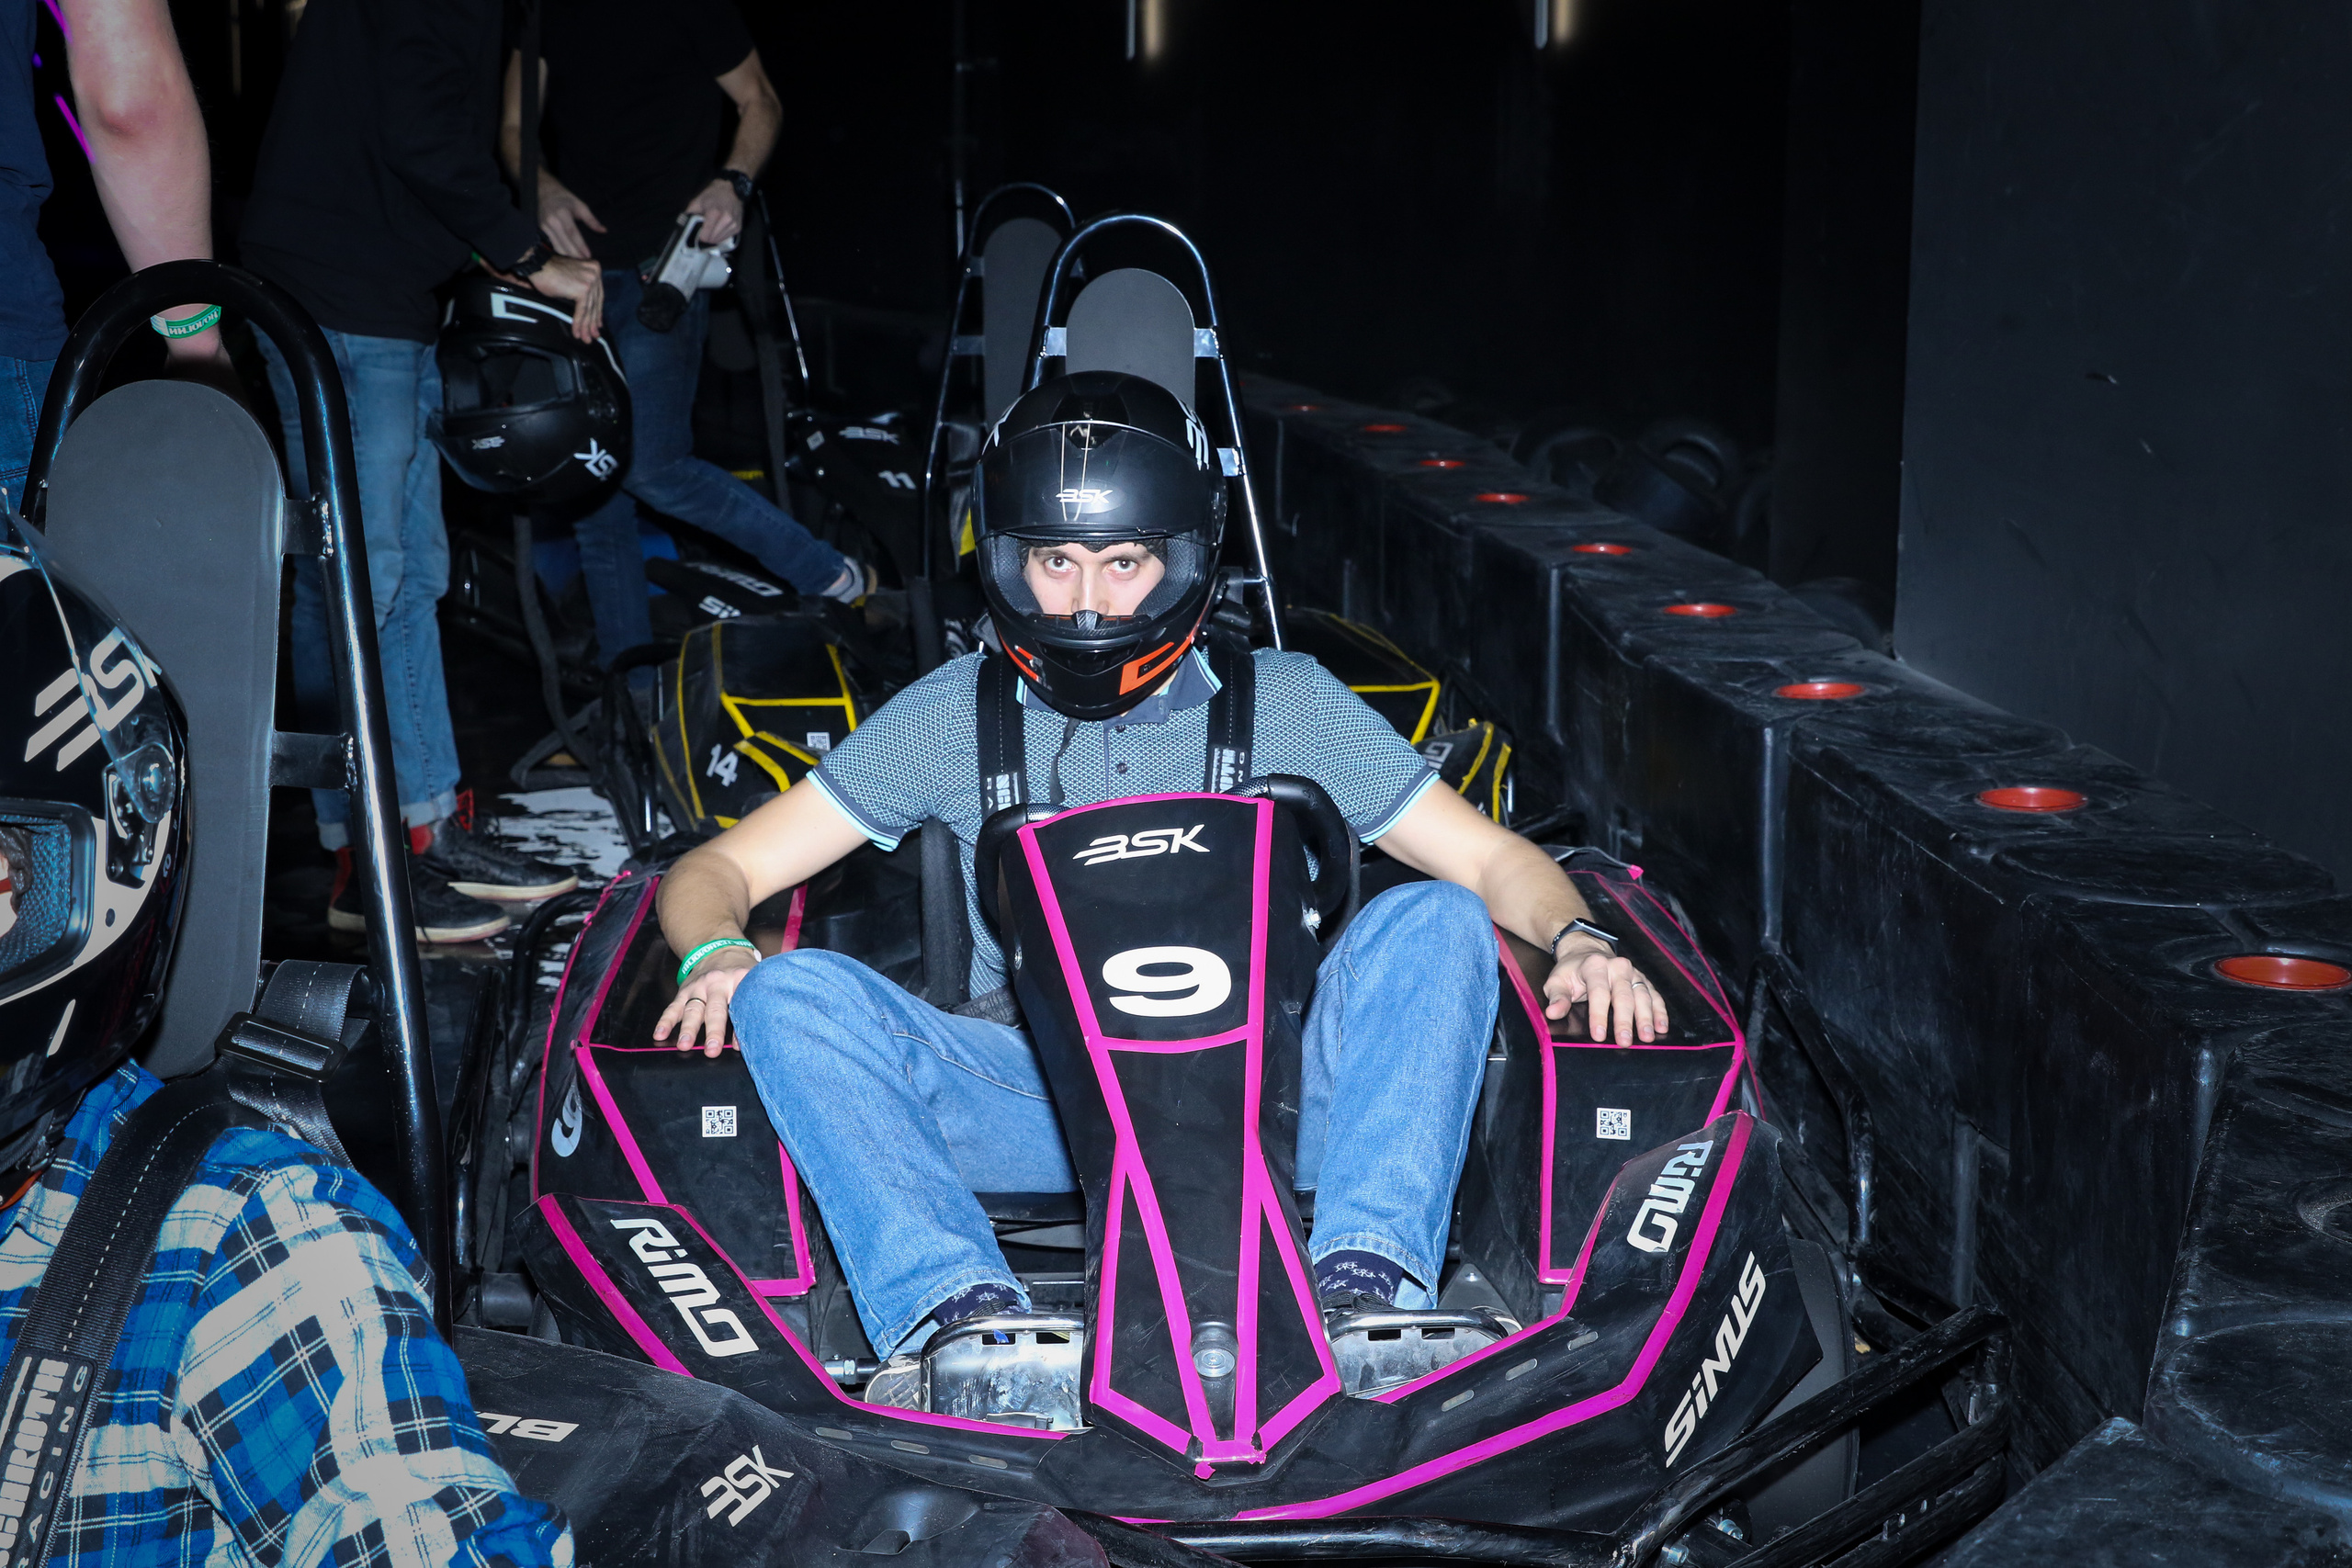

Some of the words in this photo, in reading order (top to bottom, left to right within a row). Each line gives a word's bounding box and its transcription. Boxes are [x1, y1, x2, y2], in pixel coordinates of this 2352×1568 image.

[706, 743, 739, 787] 14
[1102, 945, 1232, 1018] 9
[473, 1411, 580, 1442] BL
[0, 1358, 69, 1568] CHROTH
